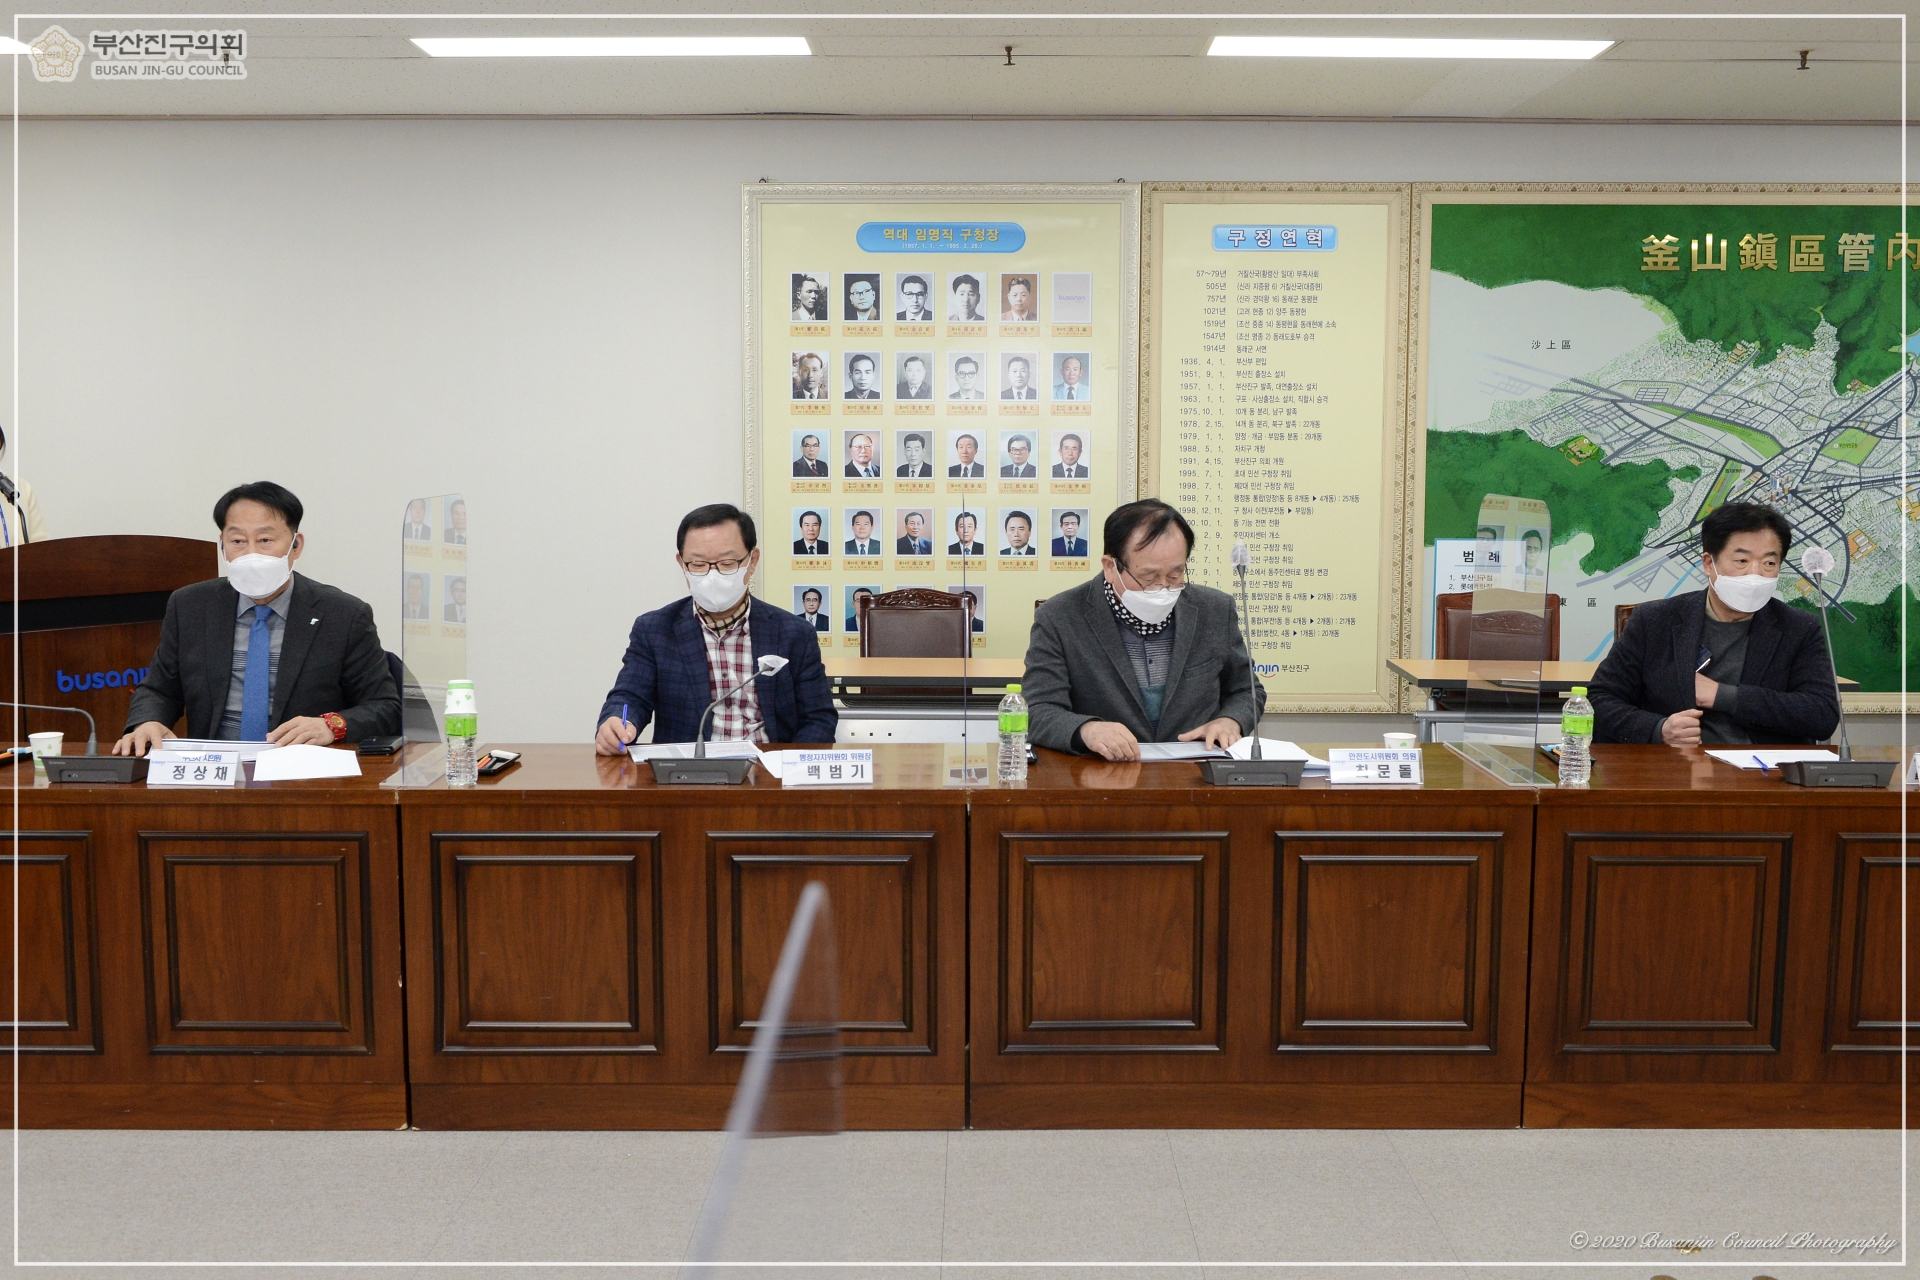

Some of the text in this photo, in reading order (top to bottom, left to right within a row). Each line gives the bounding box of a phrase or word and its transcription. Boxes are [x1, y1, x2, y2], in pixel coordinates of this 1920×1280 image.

[883, 228, 999, 242] 역대 임명직 구청장
[1281, 269, 1319, 278] 일대) 부족사회
[1206, 282, 1270, 291] 505년 (신라 지증왕
[1207, 294, 1226, 303] 757년
[1237, 294, 1250, 303] (신라
[1282, 294, 1299, 303] 동래군
[1301, 294, 1317, 303] 동평현
[1204, 307, 1306, 316] 1021년 동평현
[1204, 319, 1225, 328] 1519년
[1237, 319, 1250, 328] (조선
[1275, 319, 1298, 328] 동평현을
[1325, 319, 1336, 328] 소속
[1203, 332, 1225, 341] 1547년
[1236, 332, 1250, 341] (조선
[1304, 332, 1315, 341] 승격
[1203, 344, 1267, 353] 1914년 동래군 서면
[1181, 357, 1267, 366] 1936. 부산부 편입
[1181, 369, 1286, 378] 1951. 부산진 출장소 설치
[1181, 382, 1318, 391] 1957. 부산진구 대연출장소 설치
[1180, 394, 1328, 403] 1963. 직할시 승격
[1180, 407, 1297, 416] 1975. 10개 남구 발족
[1180, 419, 1320, 428] 1978. 14개 북구 발족 22개동
[1180, 432, 1200, 441] 1979.
[1287, 432, 1298, 441] 분동
[1180, 444, 1265, 453] 1988. 자치구 개청
[1179, 457, 1284, 466] 1991. 15. 부산진구 의회 개원
[1179, 469, 1292, 478] 1995. 초대 민선 구청장 취임
[1179, 481, 1294, 490] 1998. 제2대 민선 구청장 취임
[1179, 493, 1199, 502] 1998.
[1234, 493, 1251, 502] 행정동
[1295, 493, 1310, 502] 8개동
[1320, 493, 1336, 502] 4개동)
[1342, 493, 1360, 502] 25개동
[1179, 506, 1314, 515] 1998. 12. 청사 이전(부전동 부암동)
[1242, 518, 1280, 527] 기능 전면 전환
[1233, 530, 1280, 539] 주민자치센터 개소
[1250, 543, 1293, 552] 민선 구청장 취임
[1263, 555, 1293, 564] 구청장 취임
[1268, 567, 1301, 576] 동주민센터로
[1249, 579, 1293, 588] 민선 구청장 취임
[1293, 591, 1307, 600] 4개동
[1318, 591, 1334, 600] 2개동)
[1340, 591, 1357, 600] 23개동
[1249, 604, 1293, 613] 민선 구청장 취임
[1292, 616, 1307, 625] 4개동
[1317, 616, 1333, 625] 2개동)
[1300, 628, 1340, 637] 1개동) 20개동
[1261, 640, 1292, 649] 구청장 취임
[1281, 664, 1310, 673] 부산진구
[56, 667, 151, 693] busan
[203, 754, 222, 763] 시의원
[799, 752, 872, 762] 행정자치위원회 위원장
[1348, 752, 1417, 761] 안전도시위원회 의원
